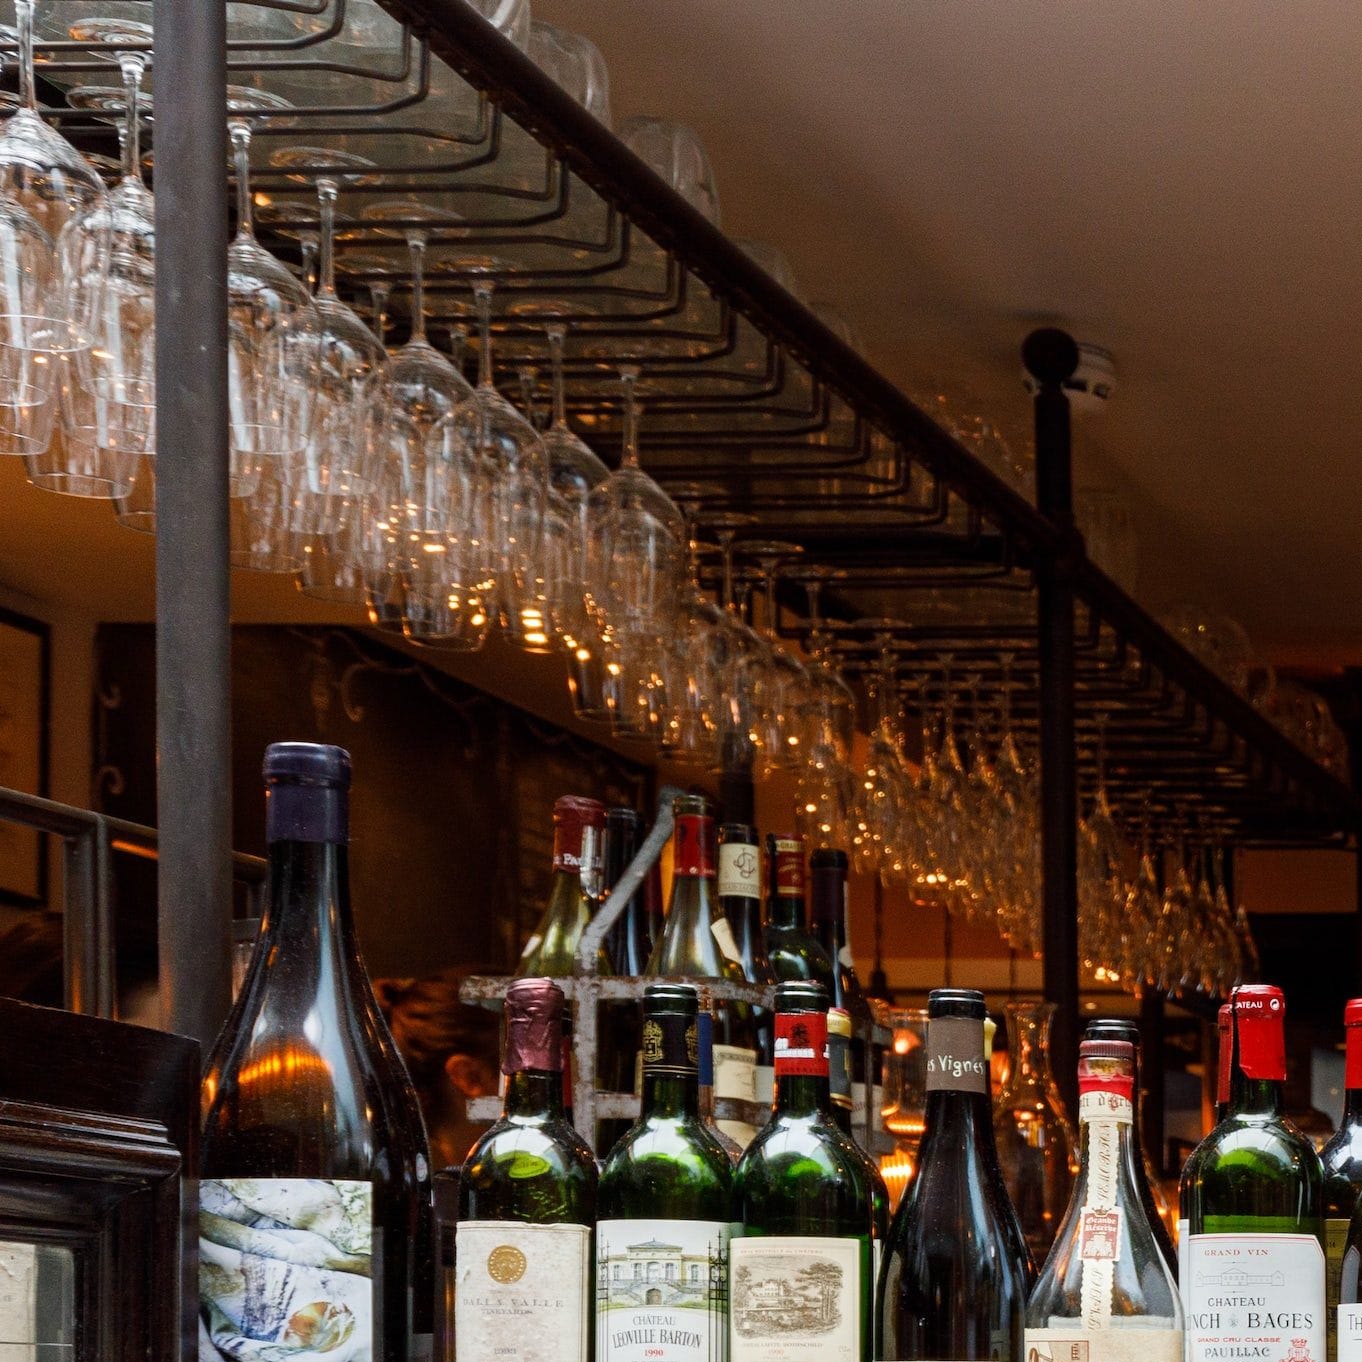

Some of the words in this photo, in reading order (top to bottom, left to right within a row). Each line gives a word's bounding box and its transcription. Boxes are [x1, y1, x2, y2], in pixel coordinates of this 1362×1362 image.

[937, 1054, 984, 1078] Vignes
[1247, 1312, 1314, 1330] BAGES
[659, 1329, 702, 1349] BARTON
[1204, 1348, 1270, 1358] PAUILLAC
